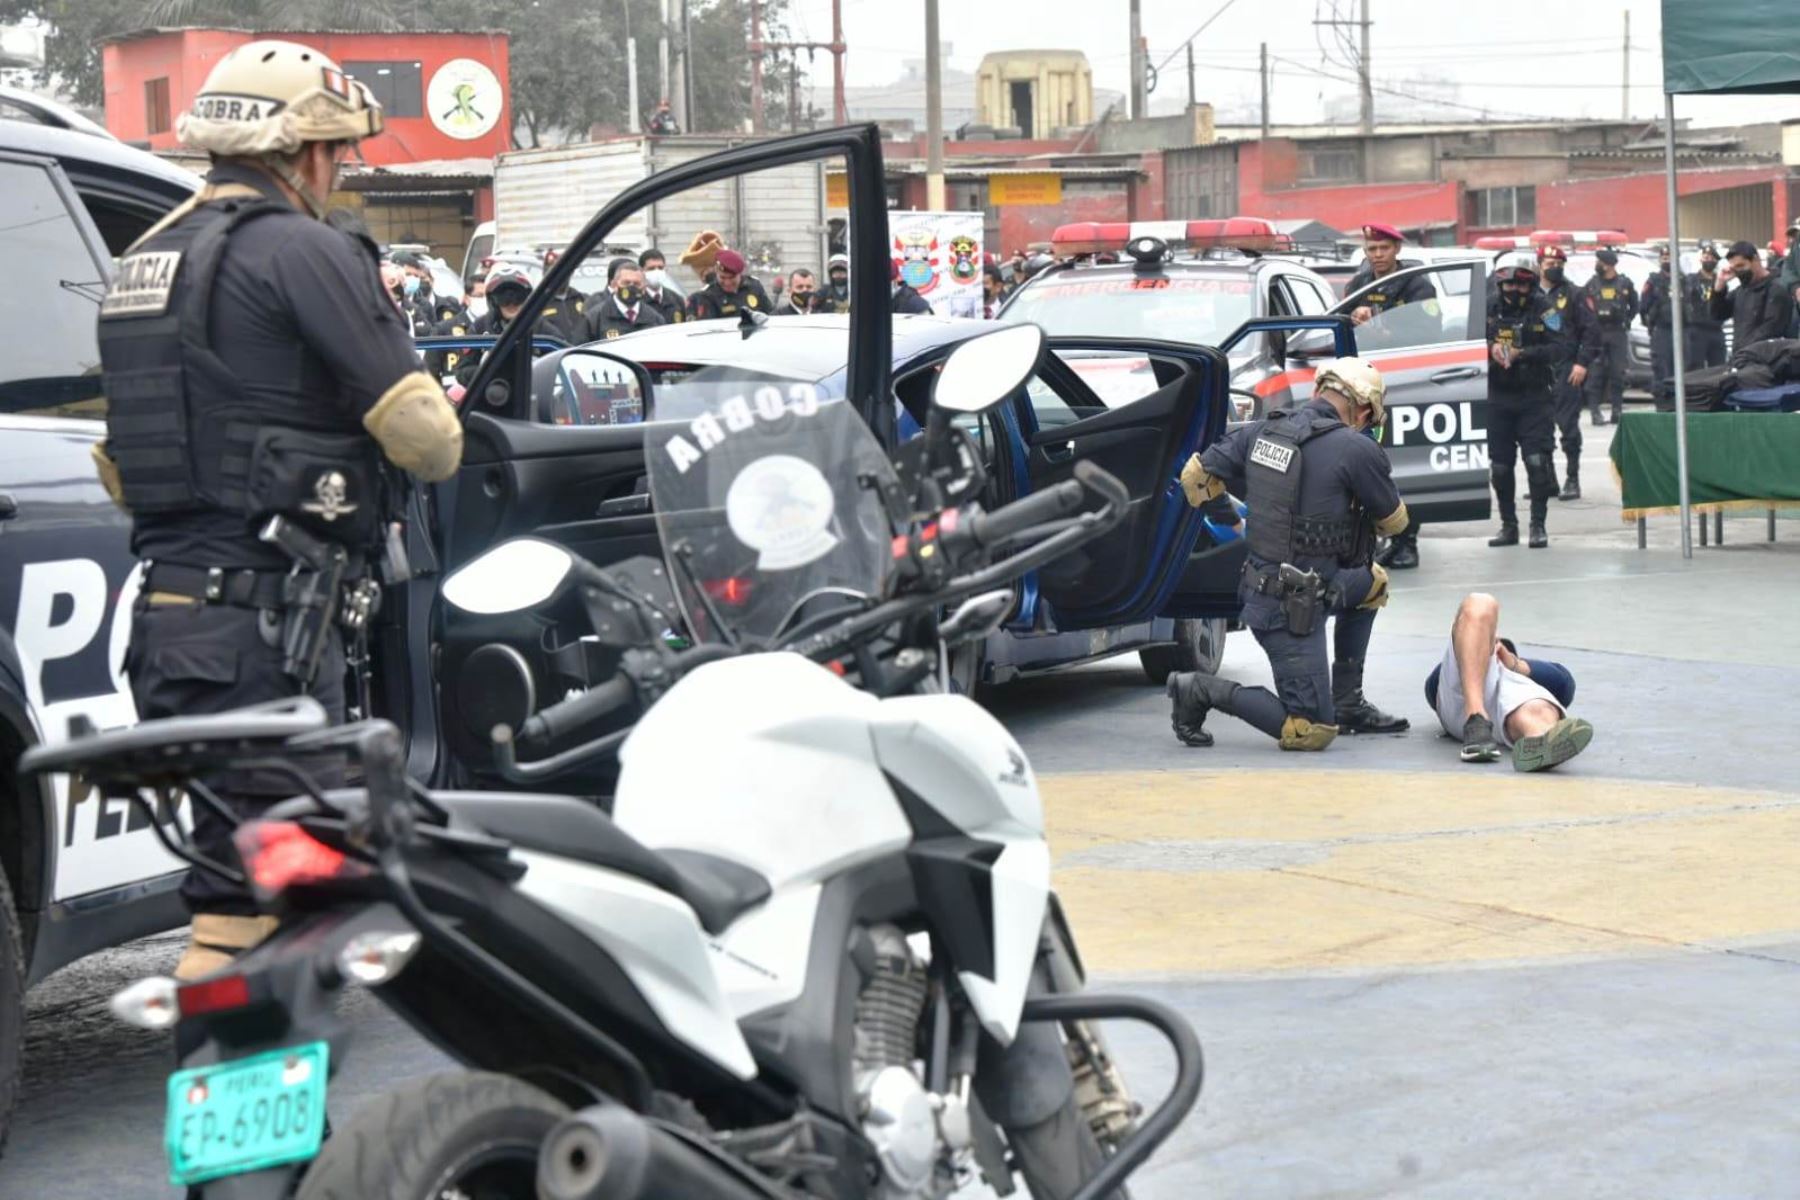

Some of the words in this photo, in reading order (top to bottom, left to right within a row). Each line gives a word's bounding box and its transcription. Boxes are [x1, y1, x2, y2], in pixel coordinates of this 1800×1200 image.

[1391, 402, 1488, 446] POL
[1254, 440, 1291, 465] POLICIA
[1429, 443, 1491, 472] CEN
[179, 1088, 310, 1163] EP-6908
